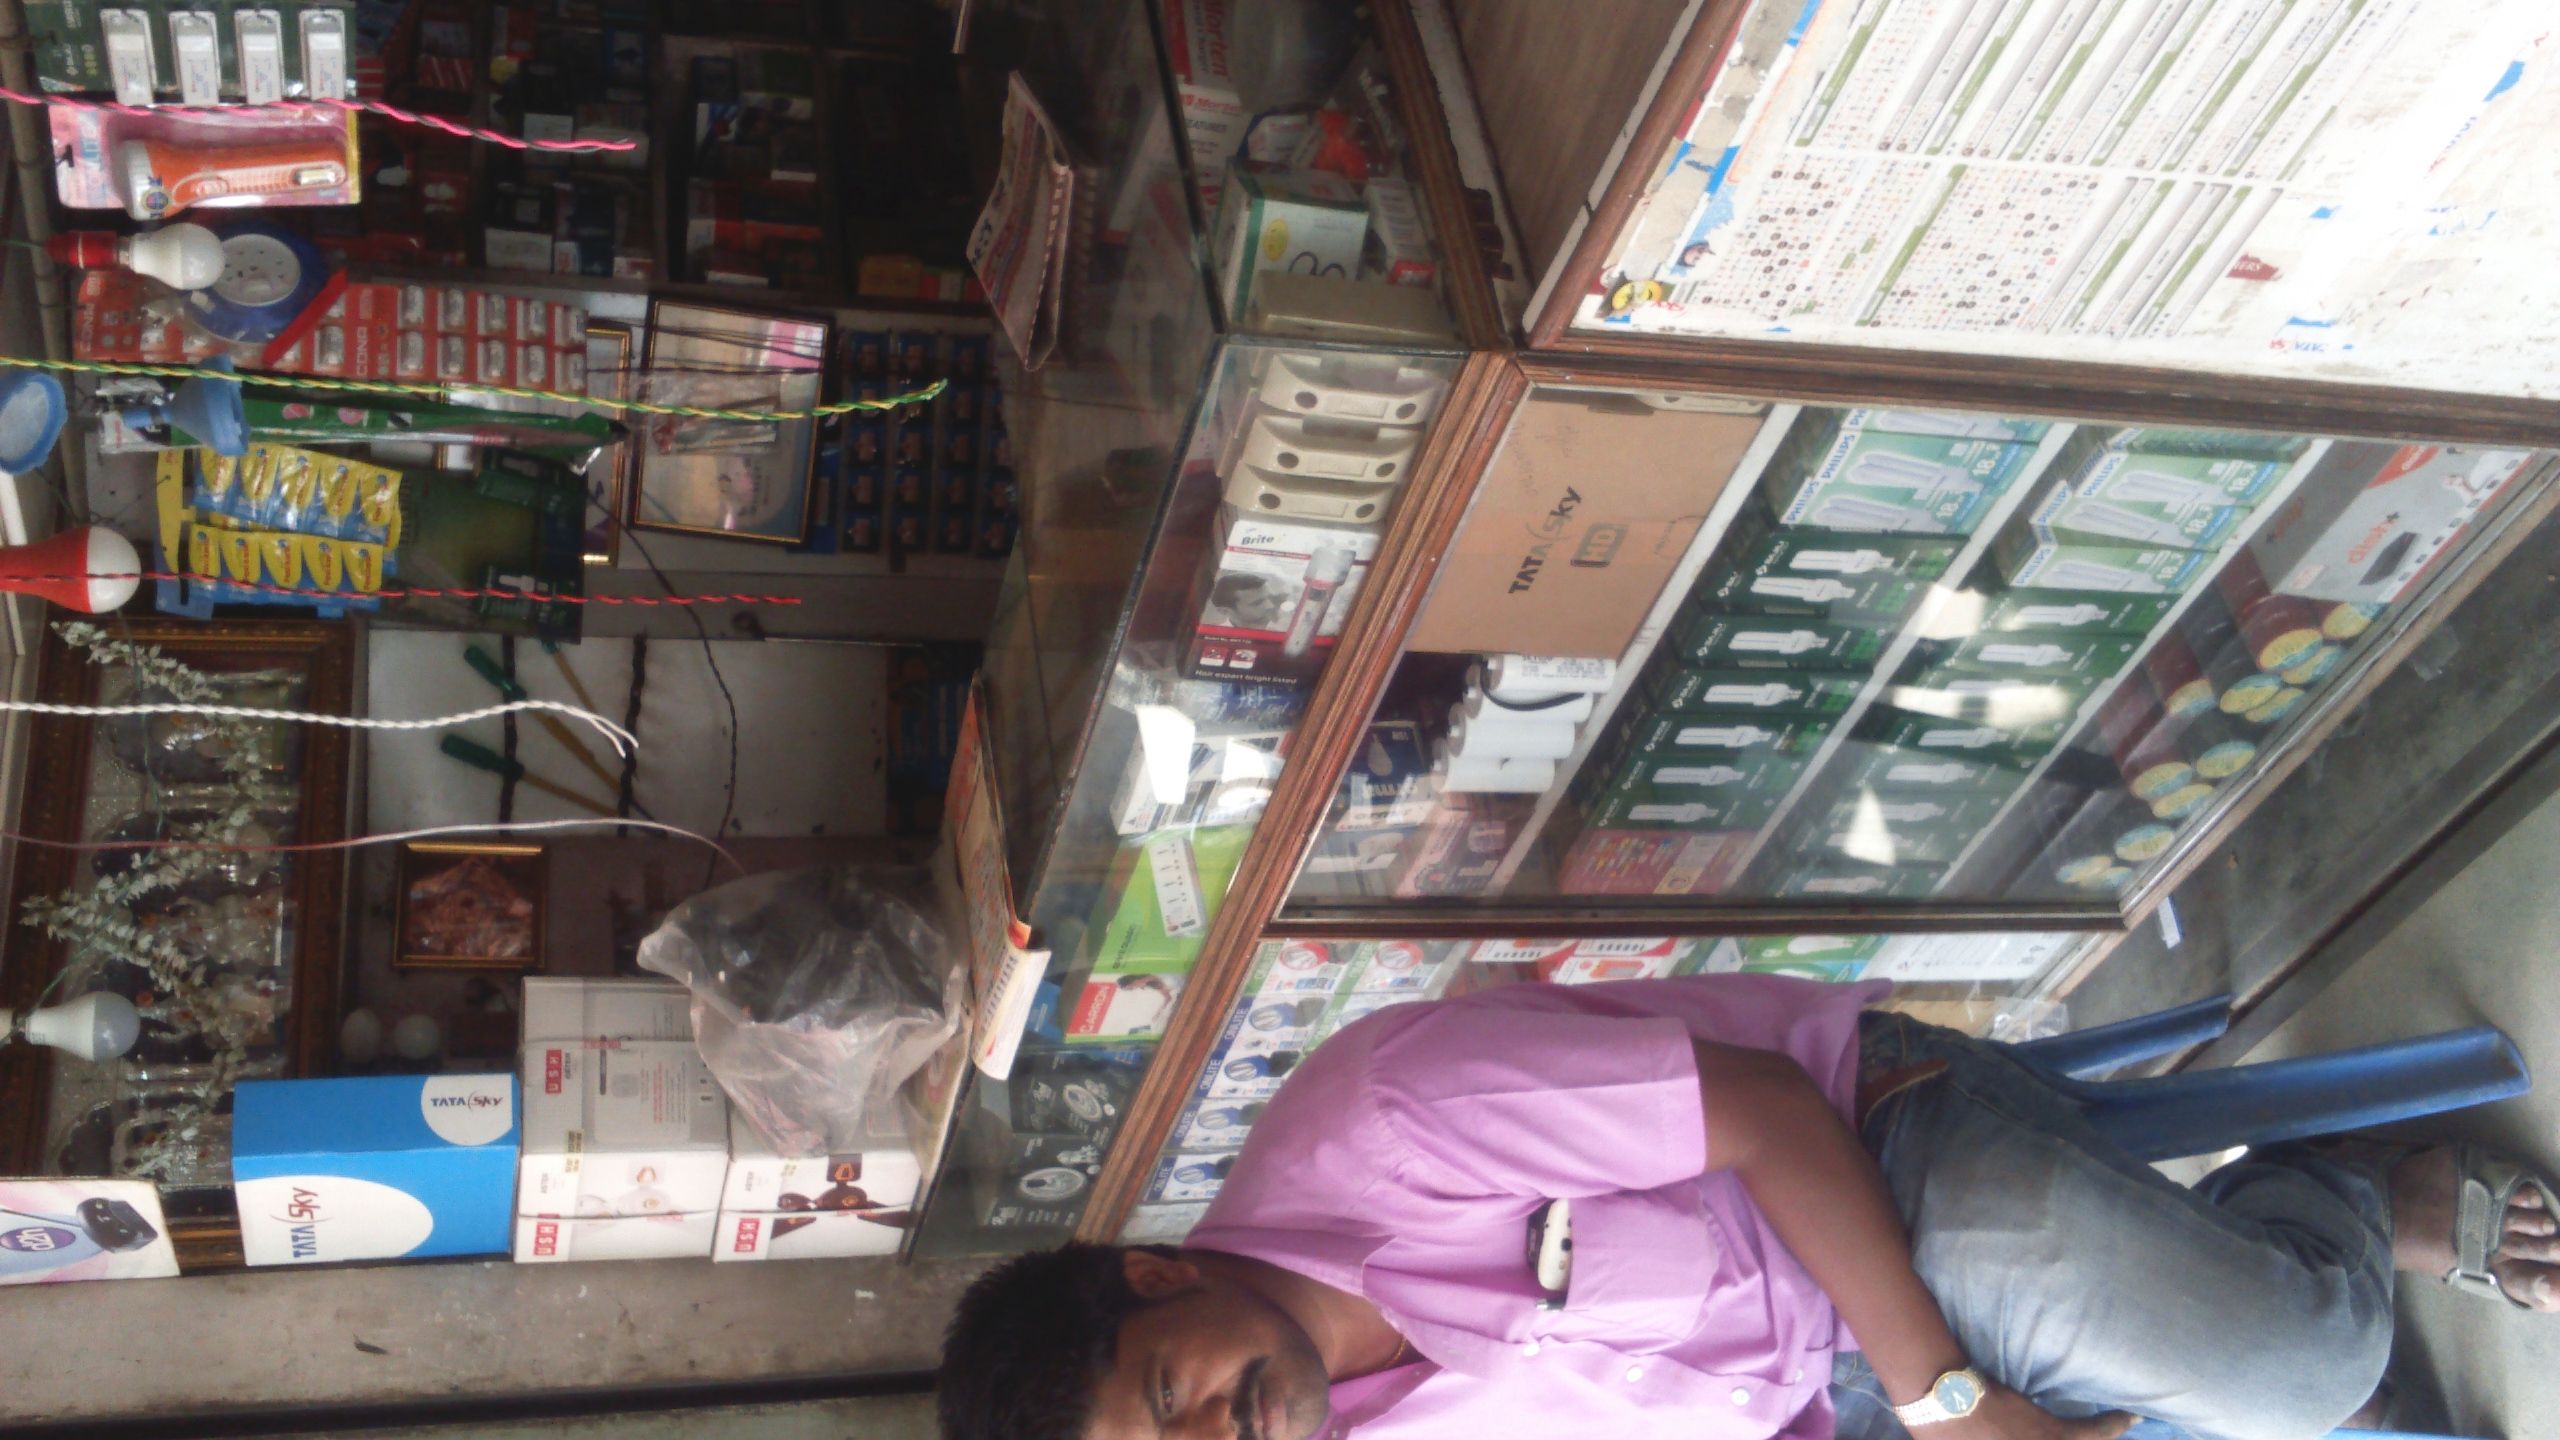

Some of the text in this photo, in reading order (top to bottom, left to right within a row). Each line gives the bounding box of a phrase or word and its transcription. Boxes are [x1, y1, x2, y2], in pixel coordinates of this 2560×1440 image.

[1820, 434, 1856, 479] PHILIPS
[1971, 458, 1996, 476] 18
[2082, 456, 2121, 496] PHILIPS
[1786, 479, 1820, 521] PHILIPS
[1240, 535, 1275, 545] Brite
[1581, 529, 1617, 560] HD
[1507, 543, 1553, 594] TATA
[2014, 548, 2051, 585] PHILIPS
[1079, 985, 1111, 1033] CARRON
[547, 1054, 560, 1092] USH
[1199, 1058, 1222, 1089] ONLITE
[430, 1096, 465, 1107] TATA
[17, 1228, 54, 1250] d2h
[288, 1187, 321, 1258] TATA Sky
[535, 1223, 557, 1256] USH
[739, 1221, 757, 1252] USH
